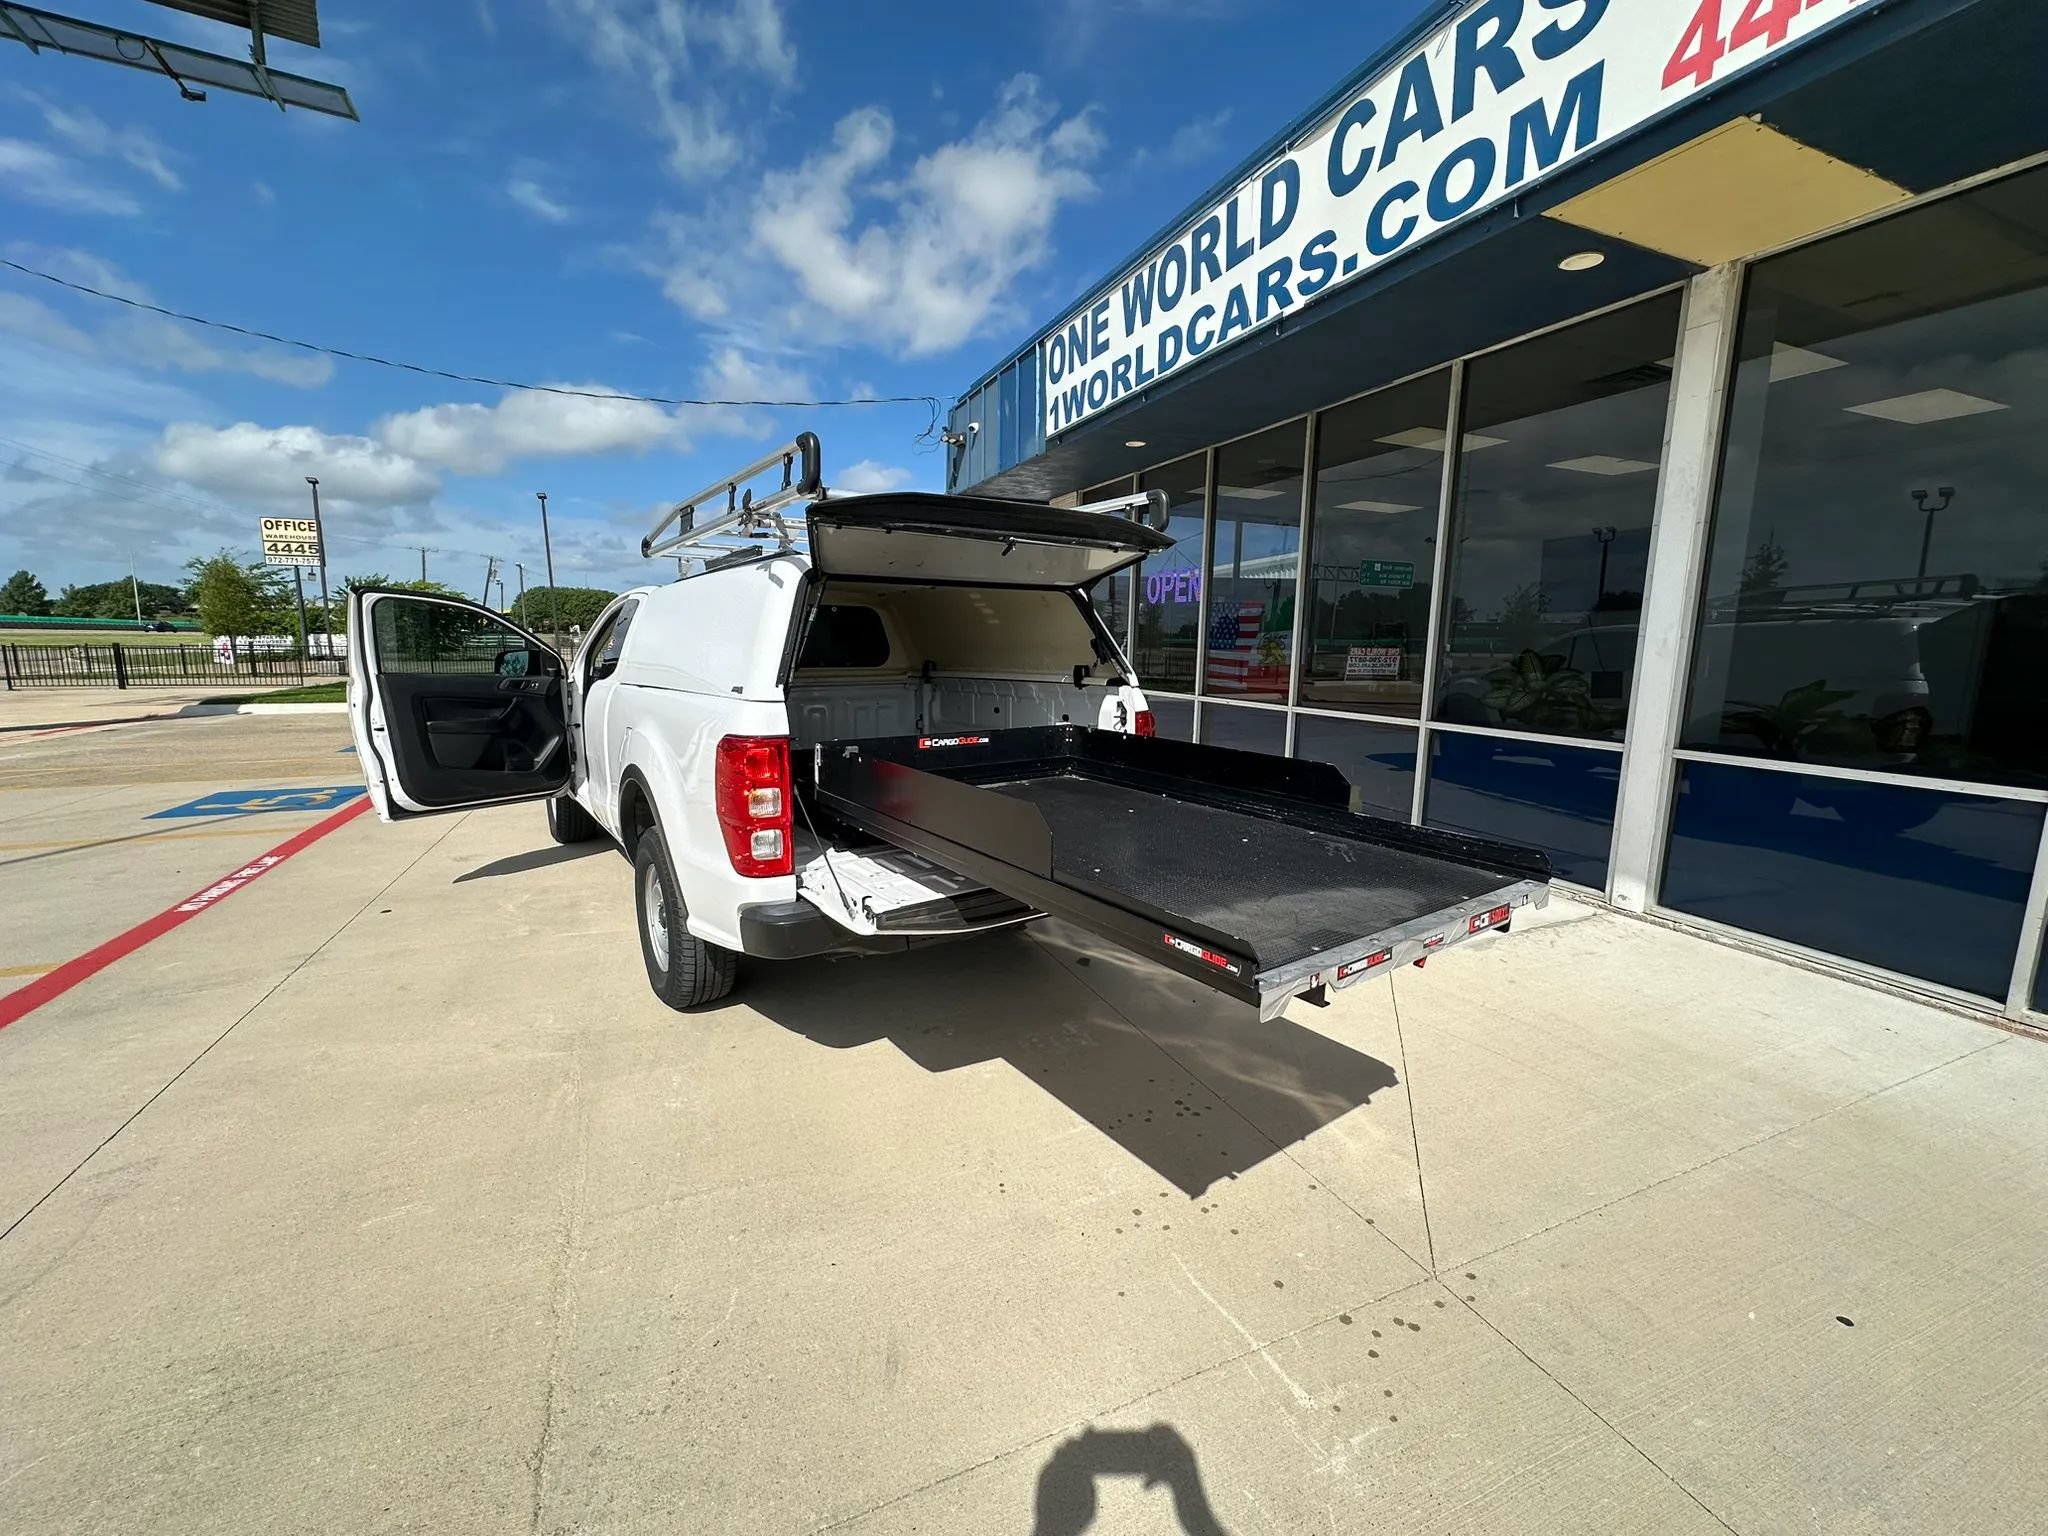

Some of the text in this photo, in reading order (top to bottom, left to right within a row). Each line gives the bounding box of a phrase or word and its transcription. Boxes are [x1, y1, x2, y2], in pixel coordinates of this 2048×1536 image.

[1049, 0, 1611, 385] ONE WORLD CARS
[1050, 58, 1605, 431] 1WORLDCARS.COM
[263, 519, 317, 532] OFFICE
[267, 543, 320, 554] 4445
[1147, 570, 1201, 604] OPEN
